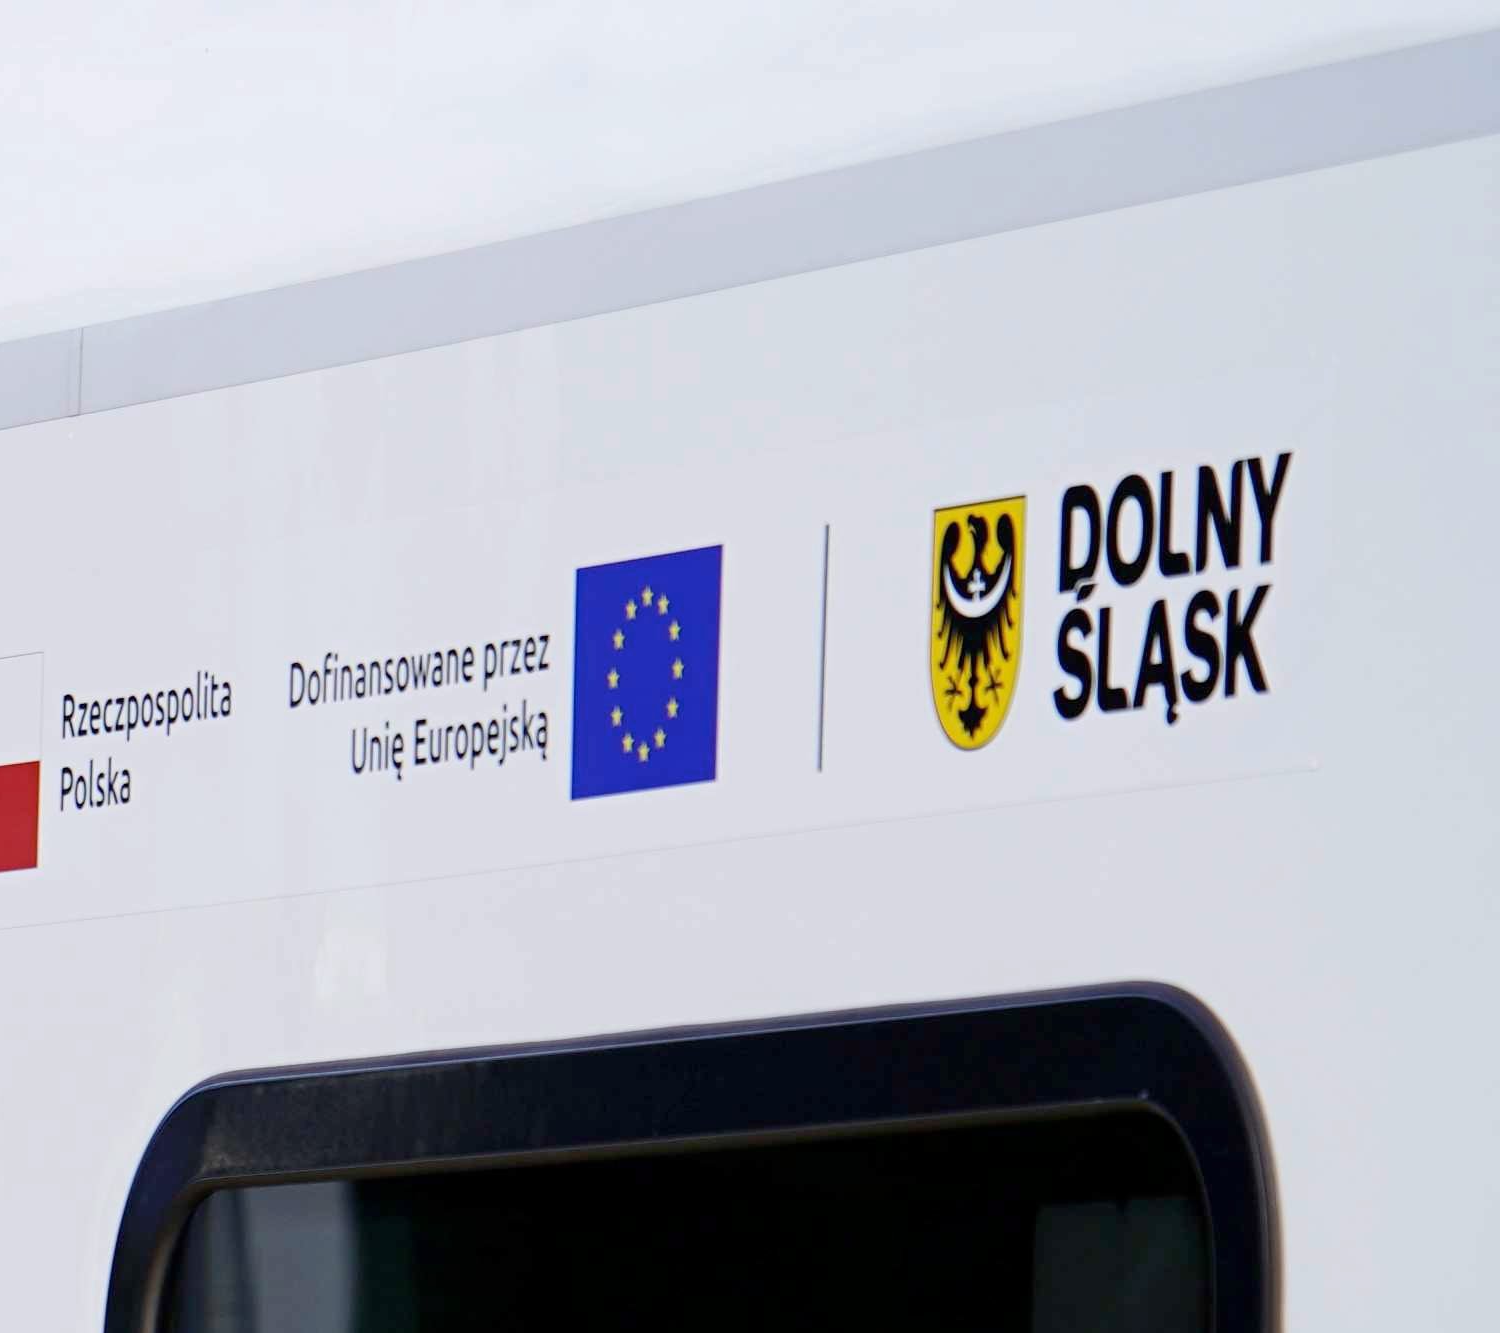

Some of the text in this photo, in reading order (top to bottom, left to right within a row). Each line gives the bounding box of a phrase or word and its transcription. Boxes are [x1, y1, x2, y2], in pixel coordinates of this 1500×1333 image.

[1060, 452, 1293, 595] DOLNY
[288, 632, 552, 709] Dofinansowane przez
[1052, 580, 1272, 726] ŚLĄSK
[61, 670, 233, 744] Rzeczpospolita
[350, 703, 550, 780] Unię Europejską
[60, 757, 132, 812] Polska
